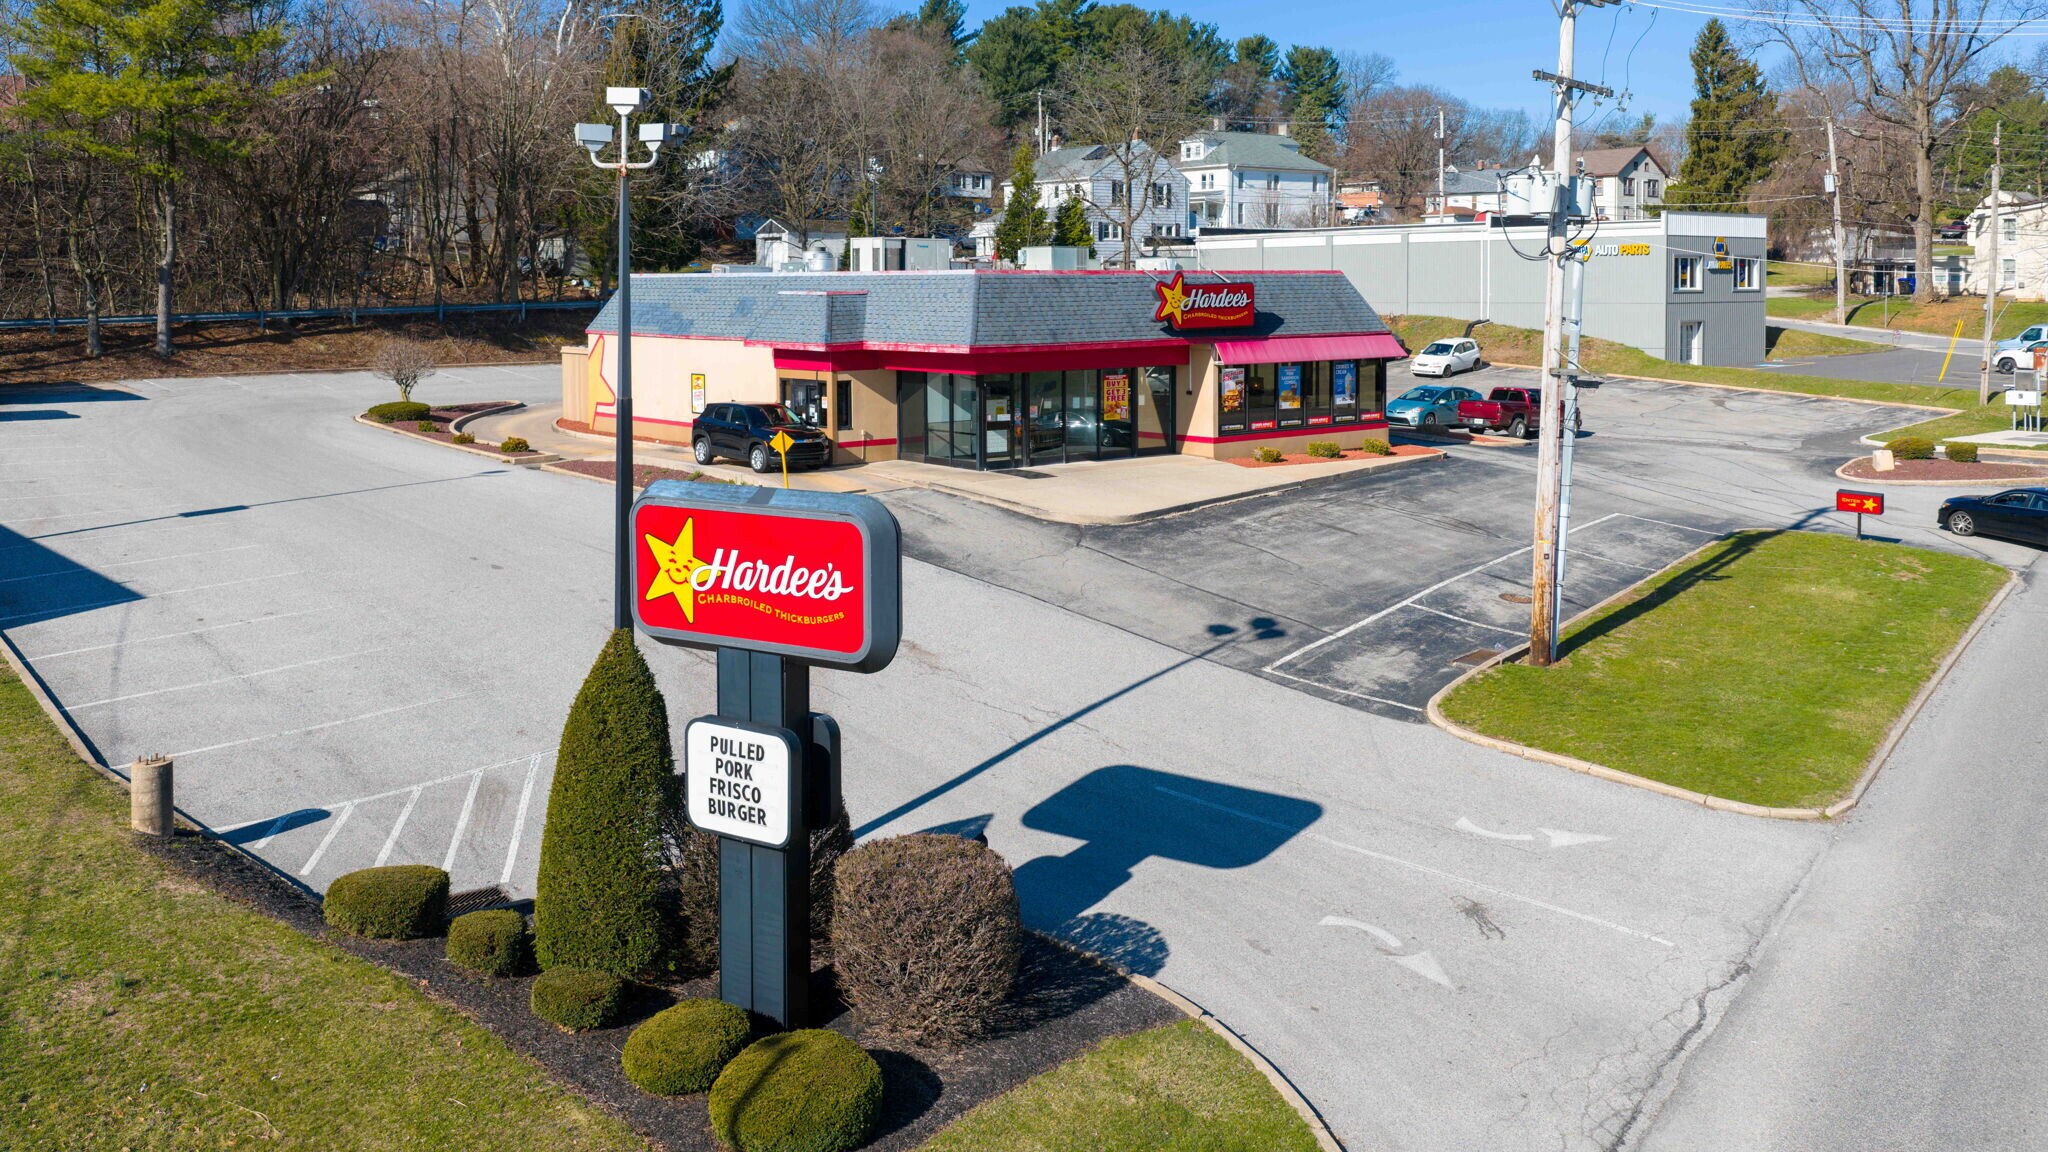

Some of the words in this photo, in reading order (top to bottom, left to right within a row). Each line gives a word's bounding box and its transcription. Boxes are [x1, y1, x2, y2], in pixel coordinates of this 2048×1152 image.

[1595, 245, 1618, 256] AUTO
[1619, 244, 1650, 256] PARTS
[1181, 288, 1251, 311] Hardee's
[1106, 394, 1126, 402] FREE
[690, 548, 854, 601] Hardee's
[698, 593, 772, 615] CHARBROILED
[775, 608, 845, 625] THICKBURGERS
[710, 735, 765, 762] PULLED
[715, 757, 753, 781] PORK
[709, 777, 762, 804] FRISCO
[708, 798, 767, 826] BURGER
